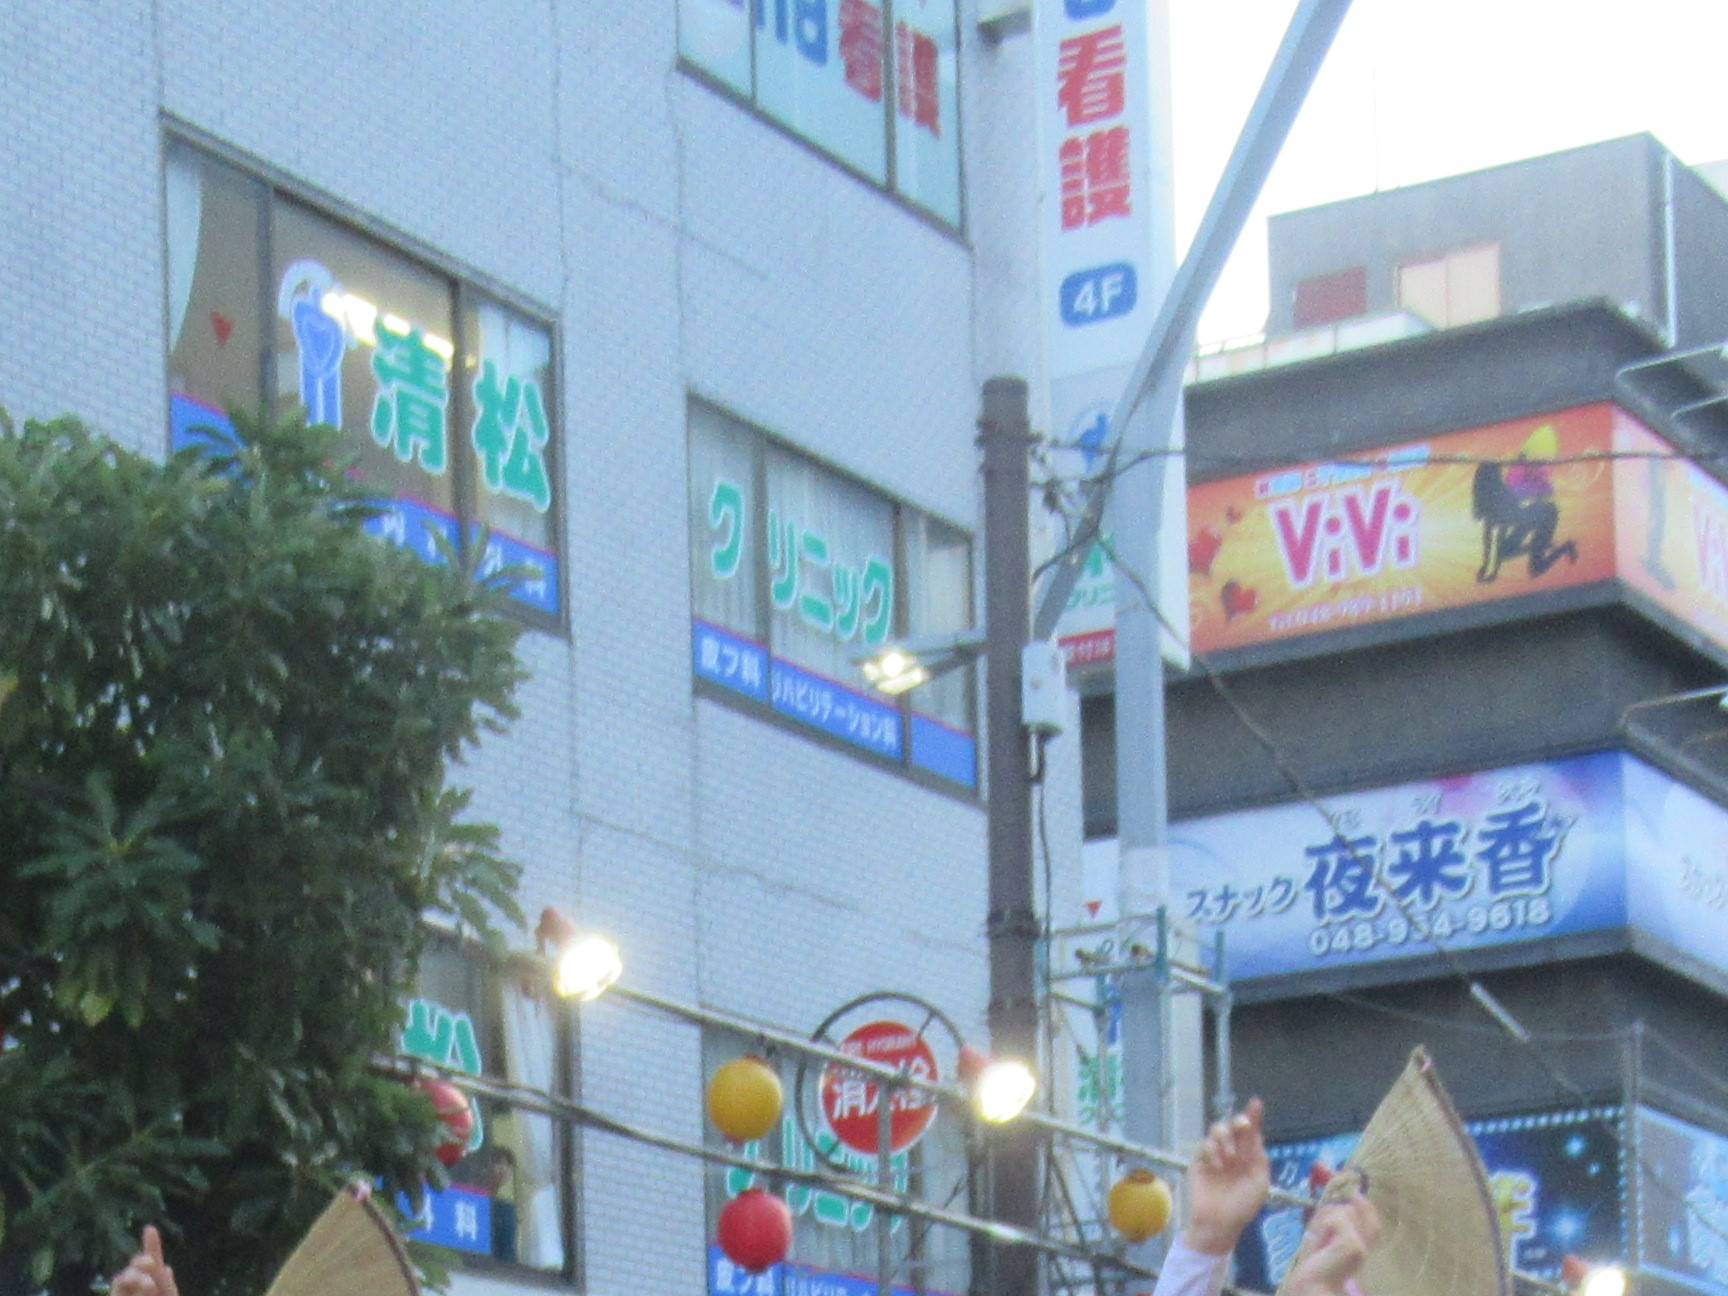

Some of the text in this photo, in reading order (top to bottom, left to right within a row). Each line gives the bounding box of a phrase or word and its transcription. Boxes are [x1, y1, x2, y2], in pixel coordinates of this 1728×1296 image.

[1058, 24, 1132, 232] 看護
[1073, 273, 1124, 316] 4F
[710, 478, 896, 647] クリニック
[1272, 482, 1418, 588] ViVi
[1185, 800, 1556, 923] スナック 夜来香
